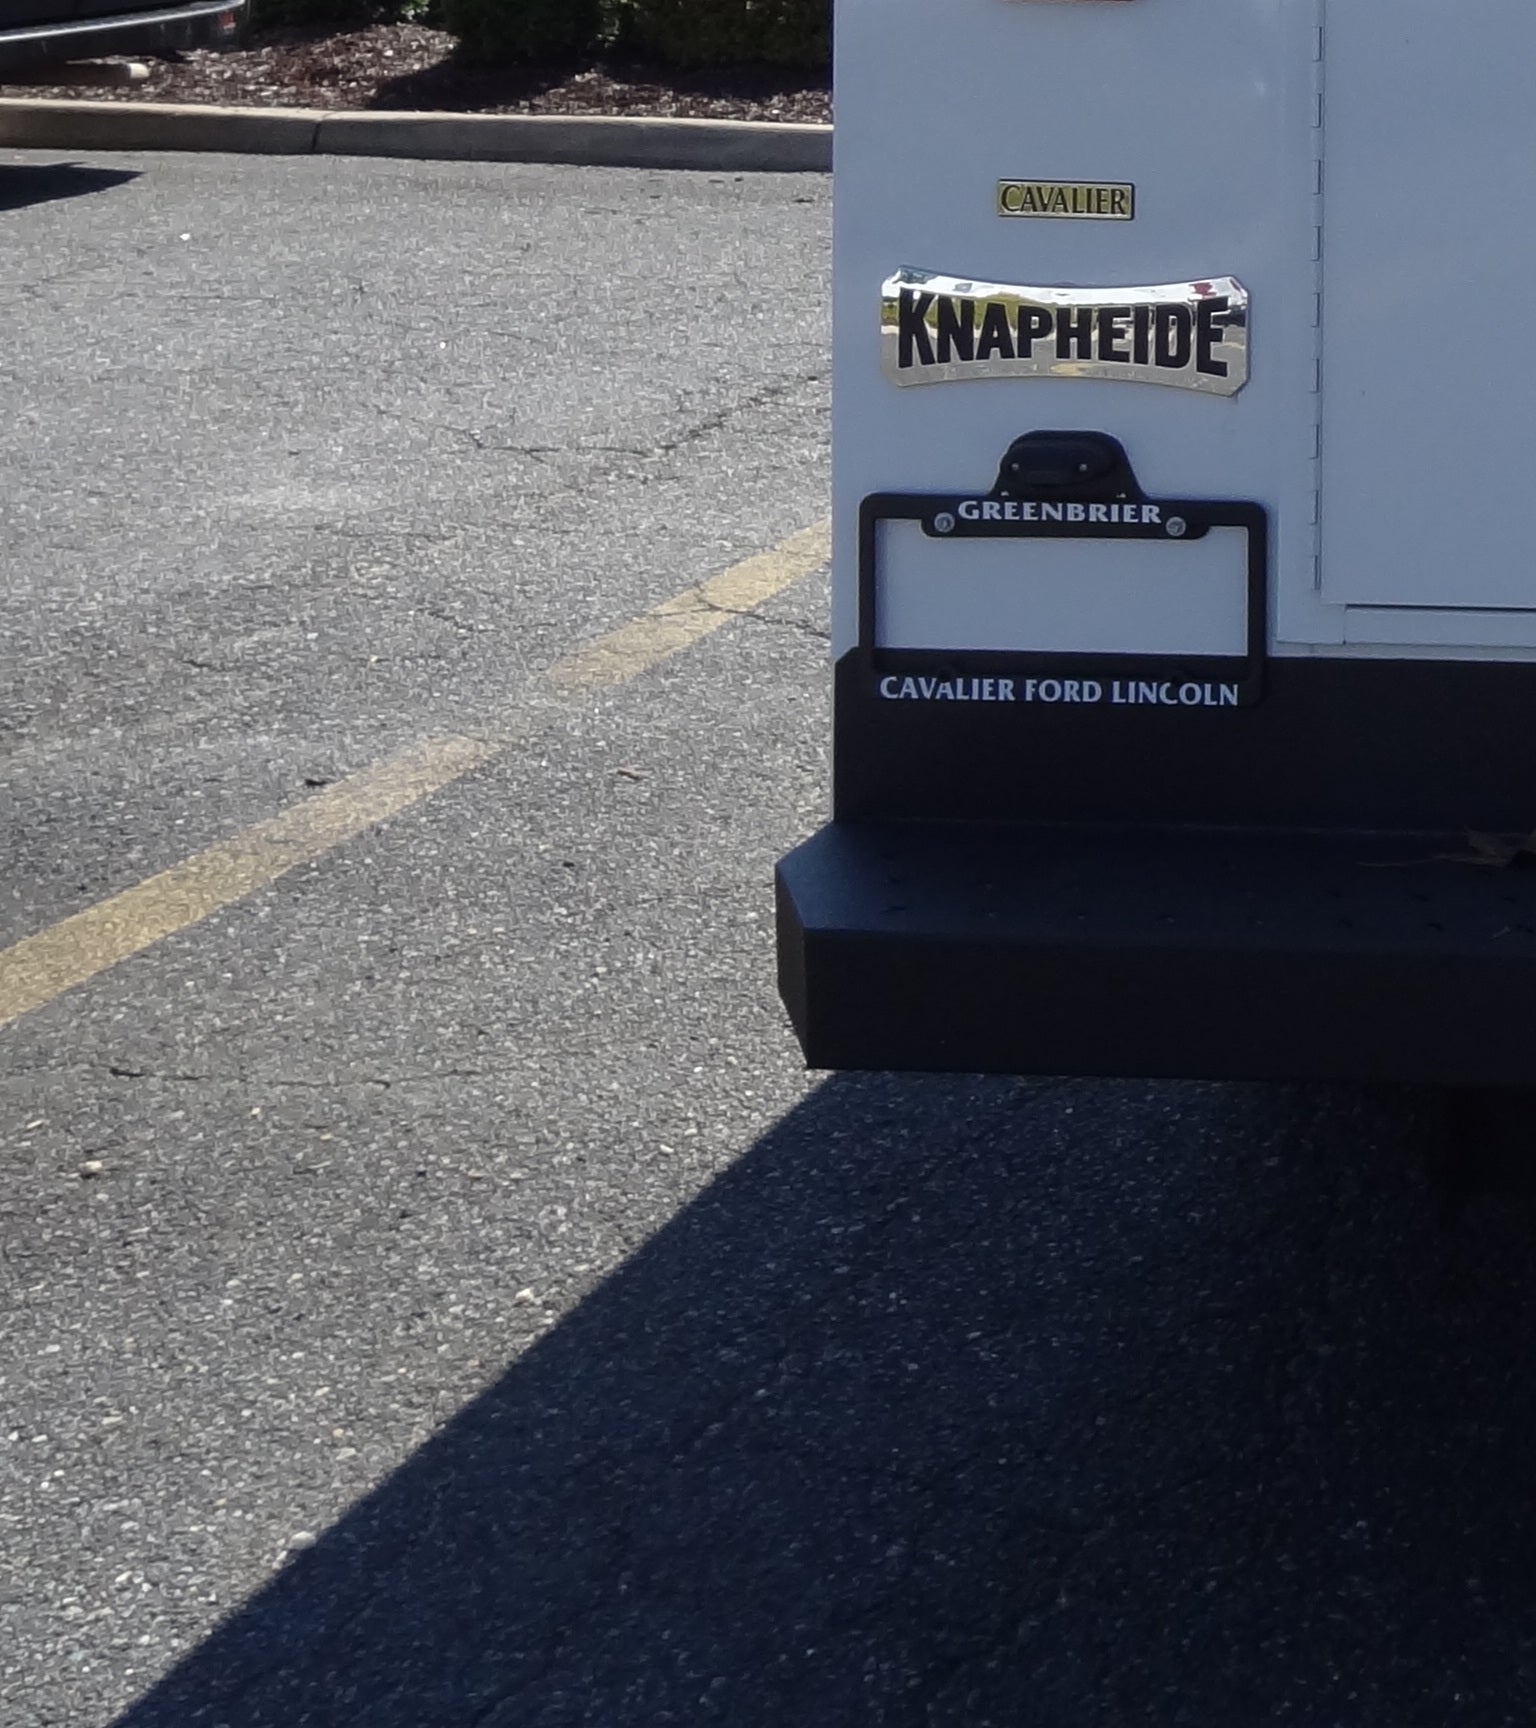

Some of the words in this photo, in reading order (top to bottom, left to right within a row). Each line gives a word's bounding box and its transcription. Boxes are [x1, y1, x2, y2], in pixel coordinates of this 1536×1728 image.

[1001, 184, 1127, 215] CAVALIER
[898, 286, 1229, 378] KNAPHEIDE
[958, 500, 1163, 524] GREENBRIER
[880, 676, 1016, 702] CAVALIER
[1024, 678, 1102, 703] FORD
[1112, 680, 1239, 706] LINCOLN
